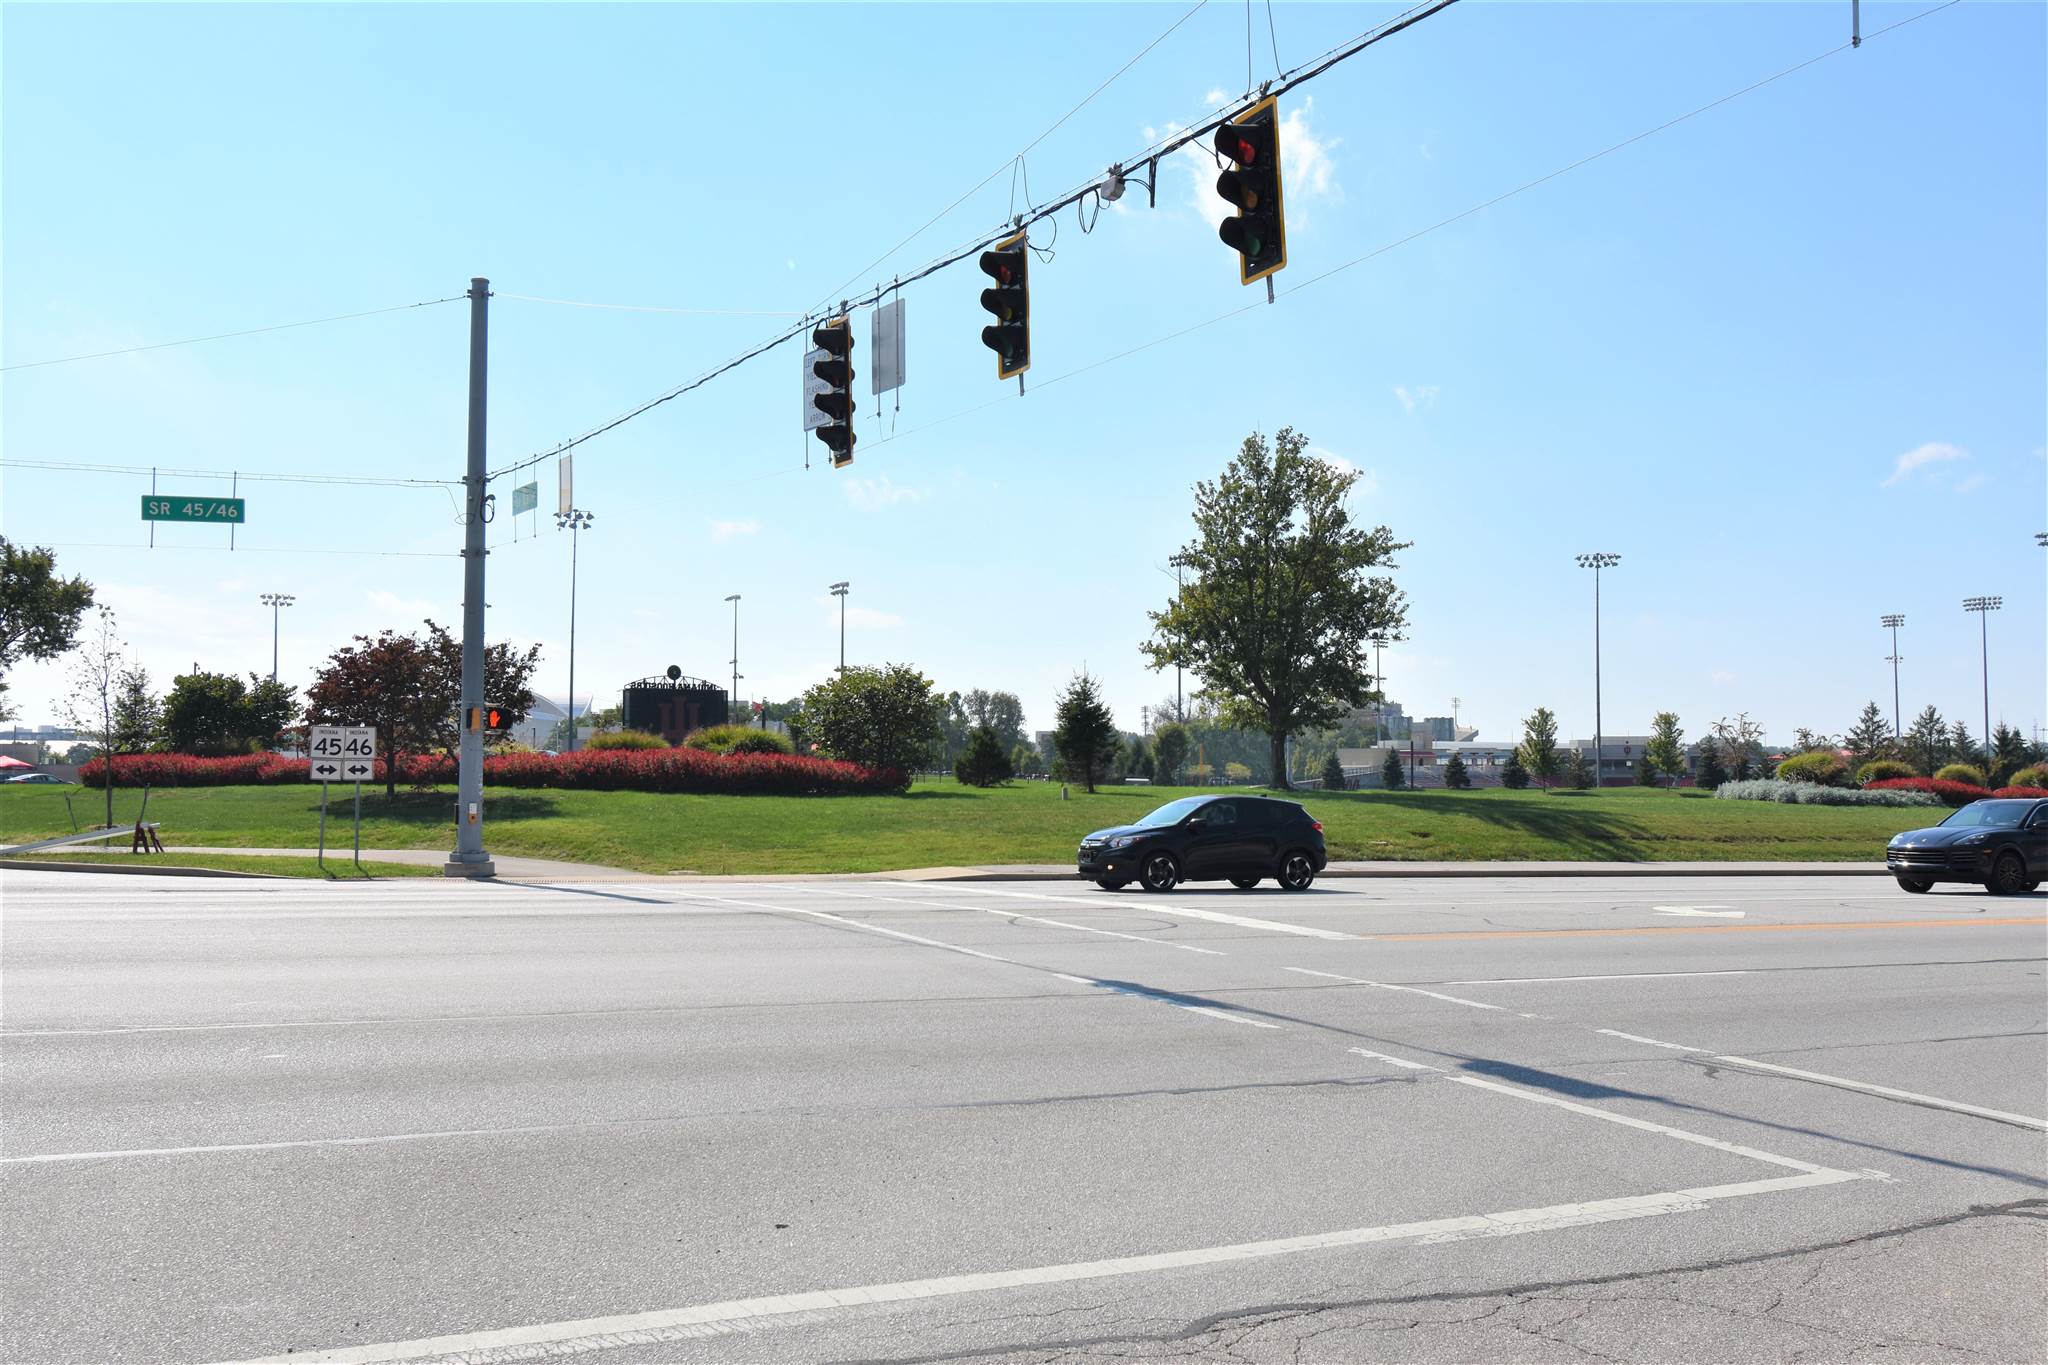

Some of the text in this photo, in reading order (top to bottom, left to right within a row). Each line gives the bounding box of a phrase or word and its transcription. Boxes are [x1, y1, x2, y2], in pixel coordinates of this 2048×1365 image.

[149, 501, 238, 518] SR 45/46
[314, 738, 341, 755] 45
[345, 738, 372, 755] 46
